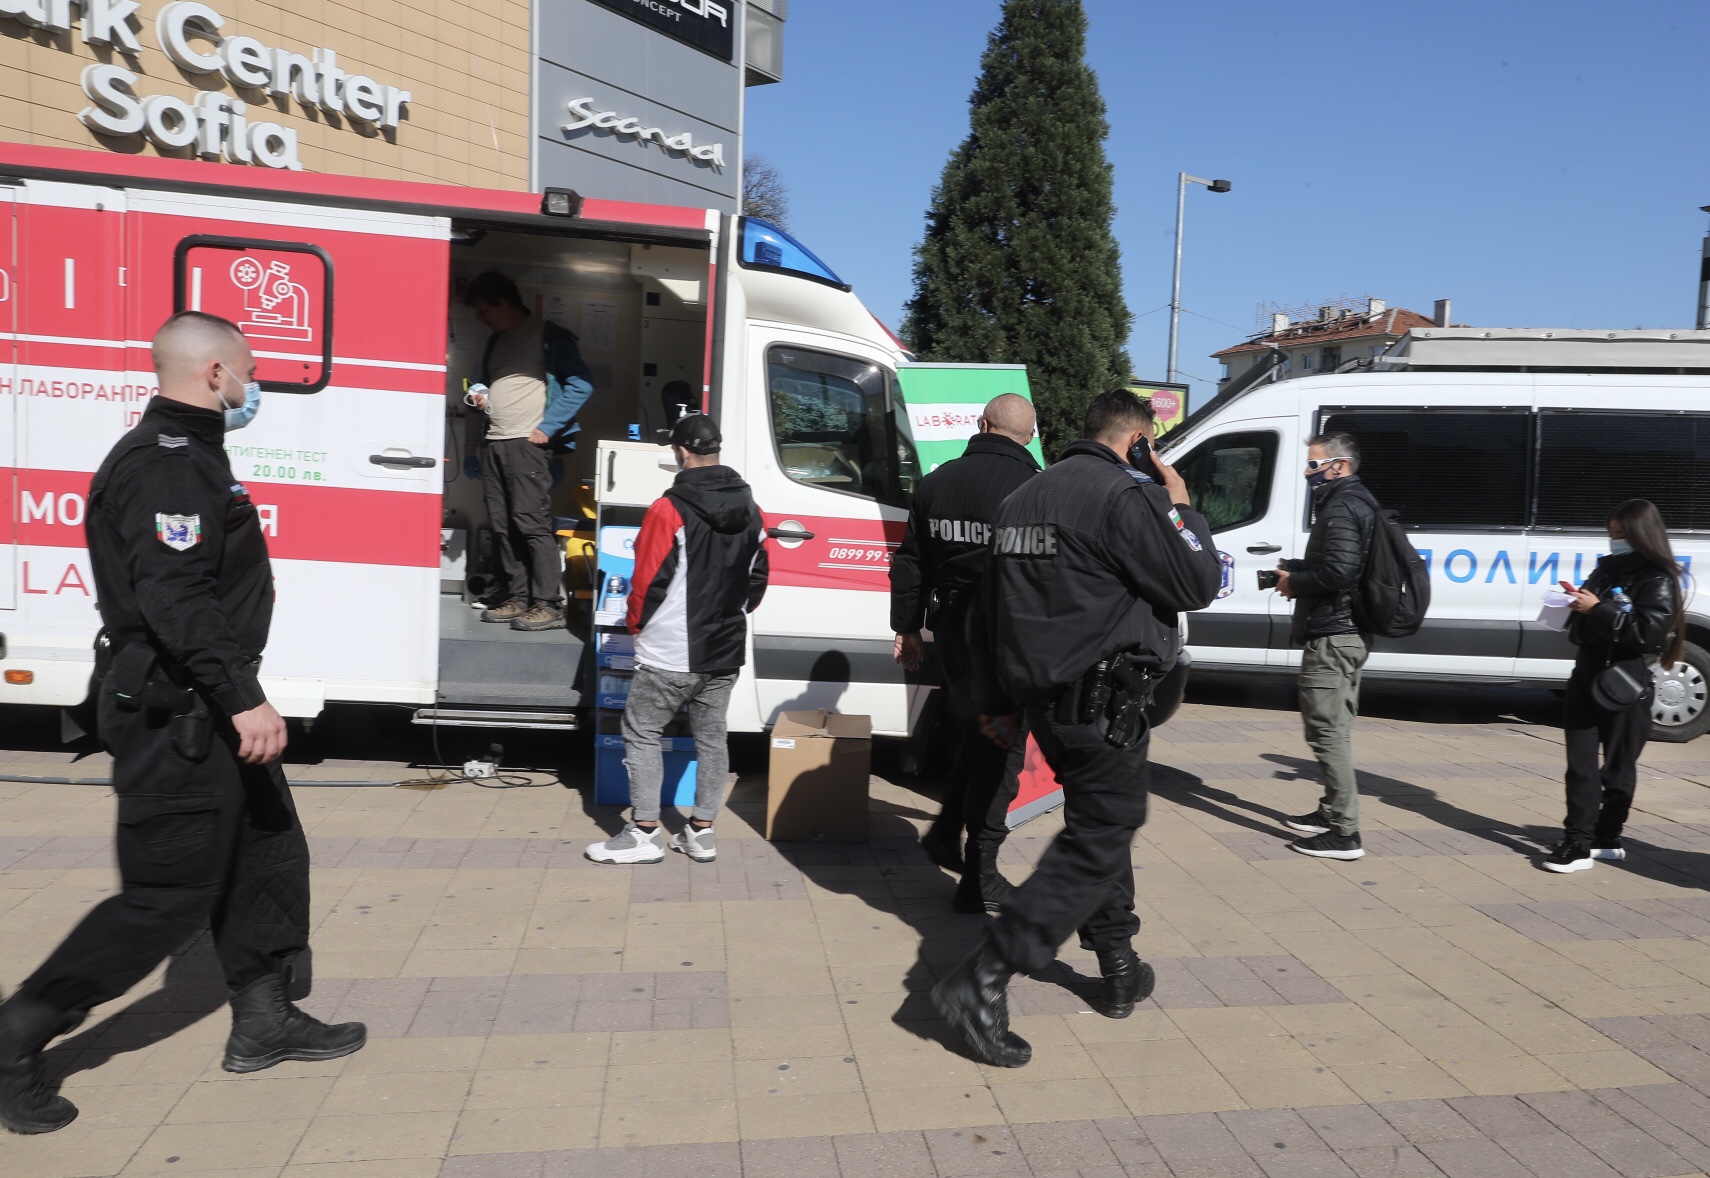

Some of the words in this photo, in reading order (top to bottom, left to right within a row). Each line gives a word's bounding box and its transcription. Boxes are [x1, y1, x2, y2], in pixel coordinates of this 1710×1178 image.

[156, 1, 411, 129] Center
[77, 64, 303, 171] Sofia
[296, 450, 328, 462] ТЕСТ
[253, 464, 296, 479] 20.00
[928, 518, 992, 545] POLICE
[994, 526, 1057, 555] POLICE
[829, 547, 864, 561] 0899
[865, 550, 883, 562] 99
[883, 551, 894, 563] 5
